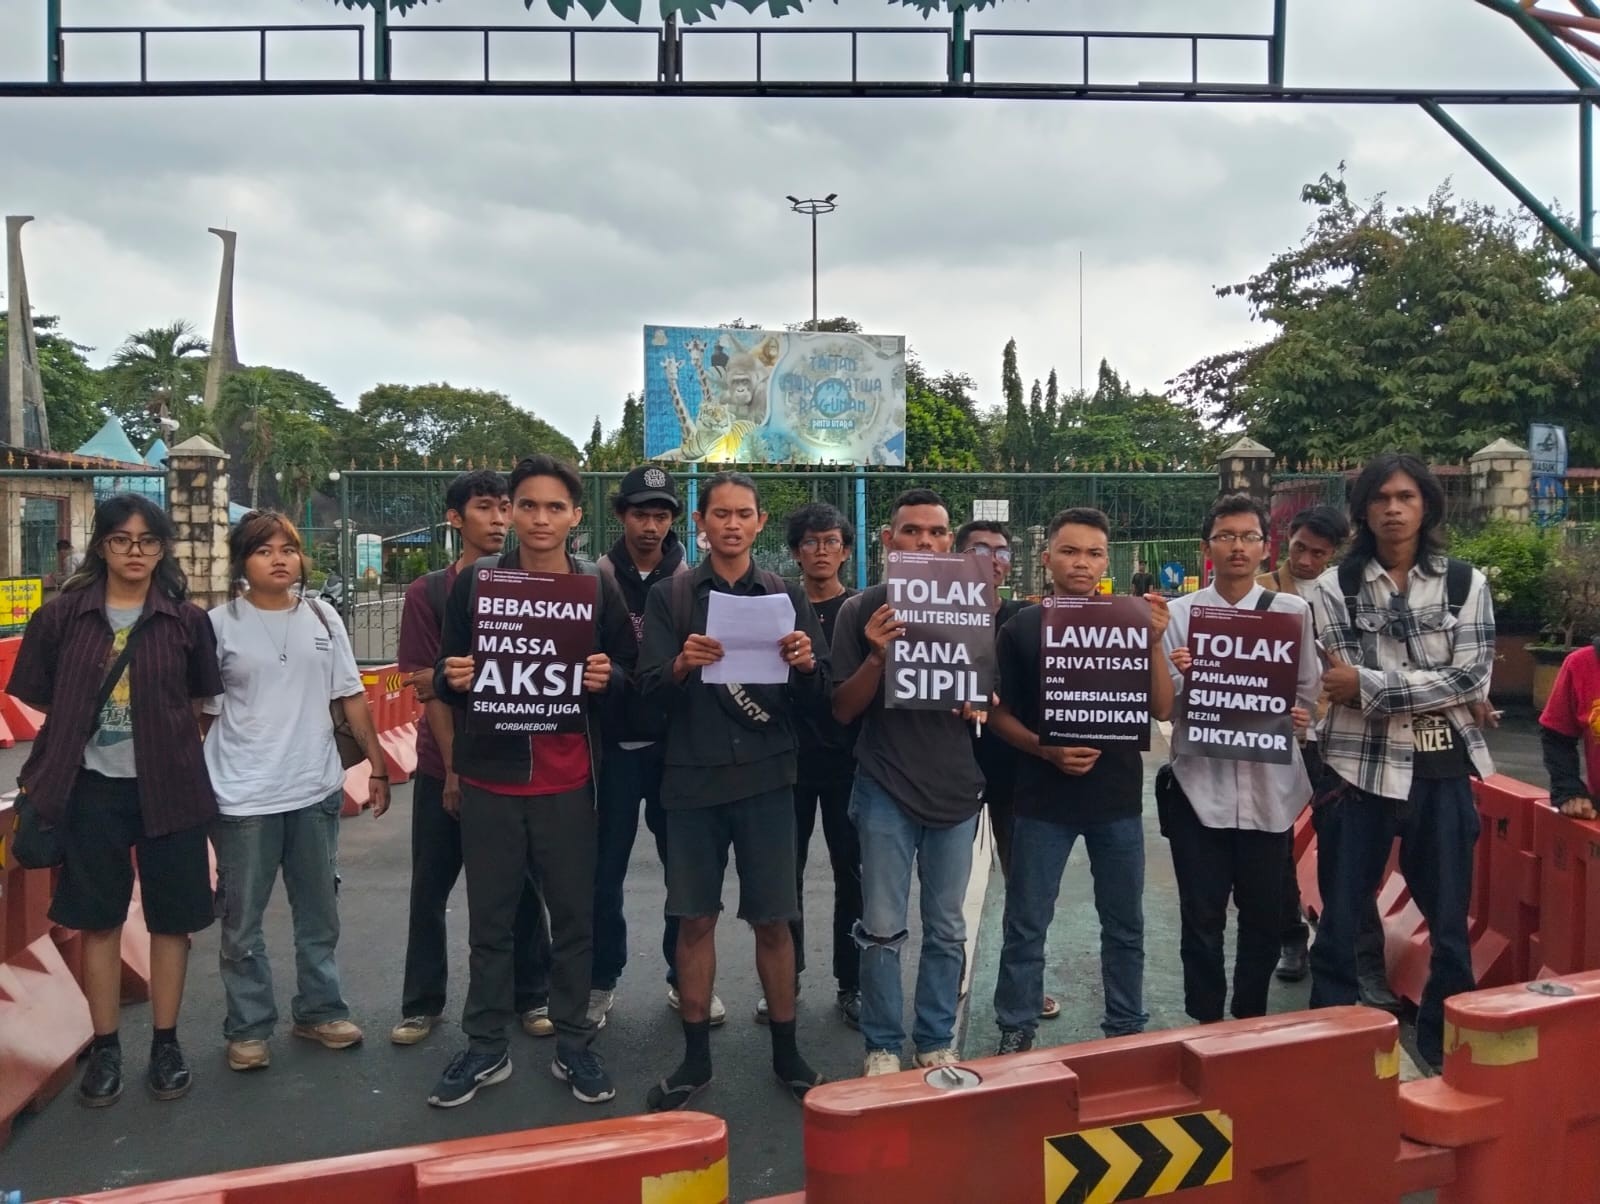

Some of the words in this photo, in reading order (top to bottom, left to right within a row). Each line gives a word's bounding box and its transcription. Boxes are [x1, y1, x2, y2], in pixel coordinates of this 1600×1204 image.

[809, 356, 858, 371] TAMAN
[888, 578, 987, 607] TOLAK
[477, 597, 593, 622] BEBASKAN
[894, 609, 991, 627] MILITERISME
[477, 620, 523, 631] SELURUH
[477, 635, 557, 656] MASSA
[1046, 625, 1148, 649] LAWAN
[894, 640, 972, 665] RANA
[1192, 633, 1295, 664] TOLAK
[1045, 656, 1149, 671] PRIVATISASI
[1192, 658, 1221, 668] GELAR
[473, 658, 585, 697] AKSI
[895, 667, 988, 703] SIPIL
[1046, 676, 1065, 684] DAN
[1191, 670, 1268, 688] PAHLAWAN
[1045, 690, 1148, 703] KOMERSIALISASI
[1188, 688, 1287, 714] SUHARTO
[473, 700, 545, 715] SEKARANG
[546, 703, 581, 717] JUGA
[1044, 708, 1149, 724] PENDIDIKAN
[1187, 711, 1221, 722] REZIM
[495, 722, 558, 731] #ORBAREBORN
[1187, 726, 1288, 751] DIKTATOR
